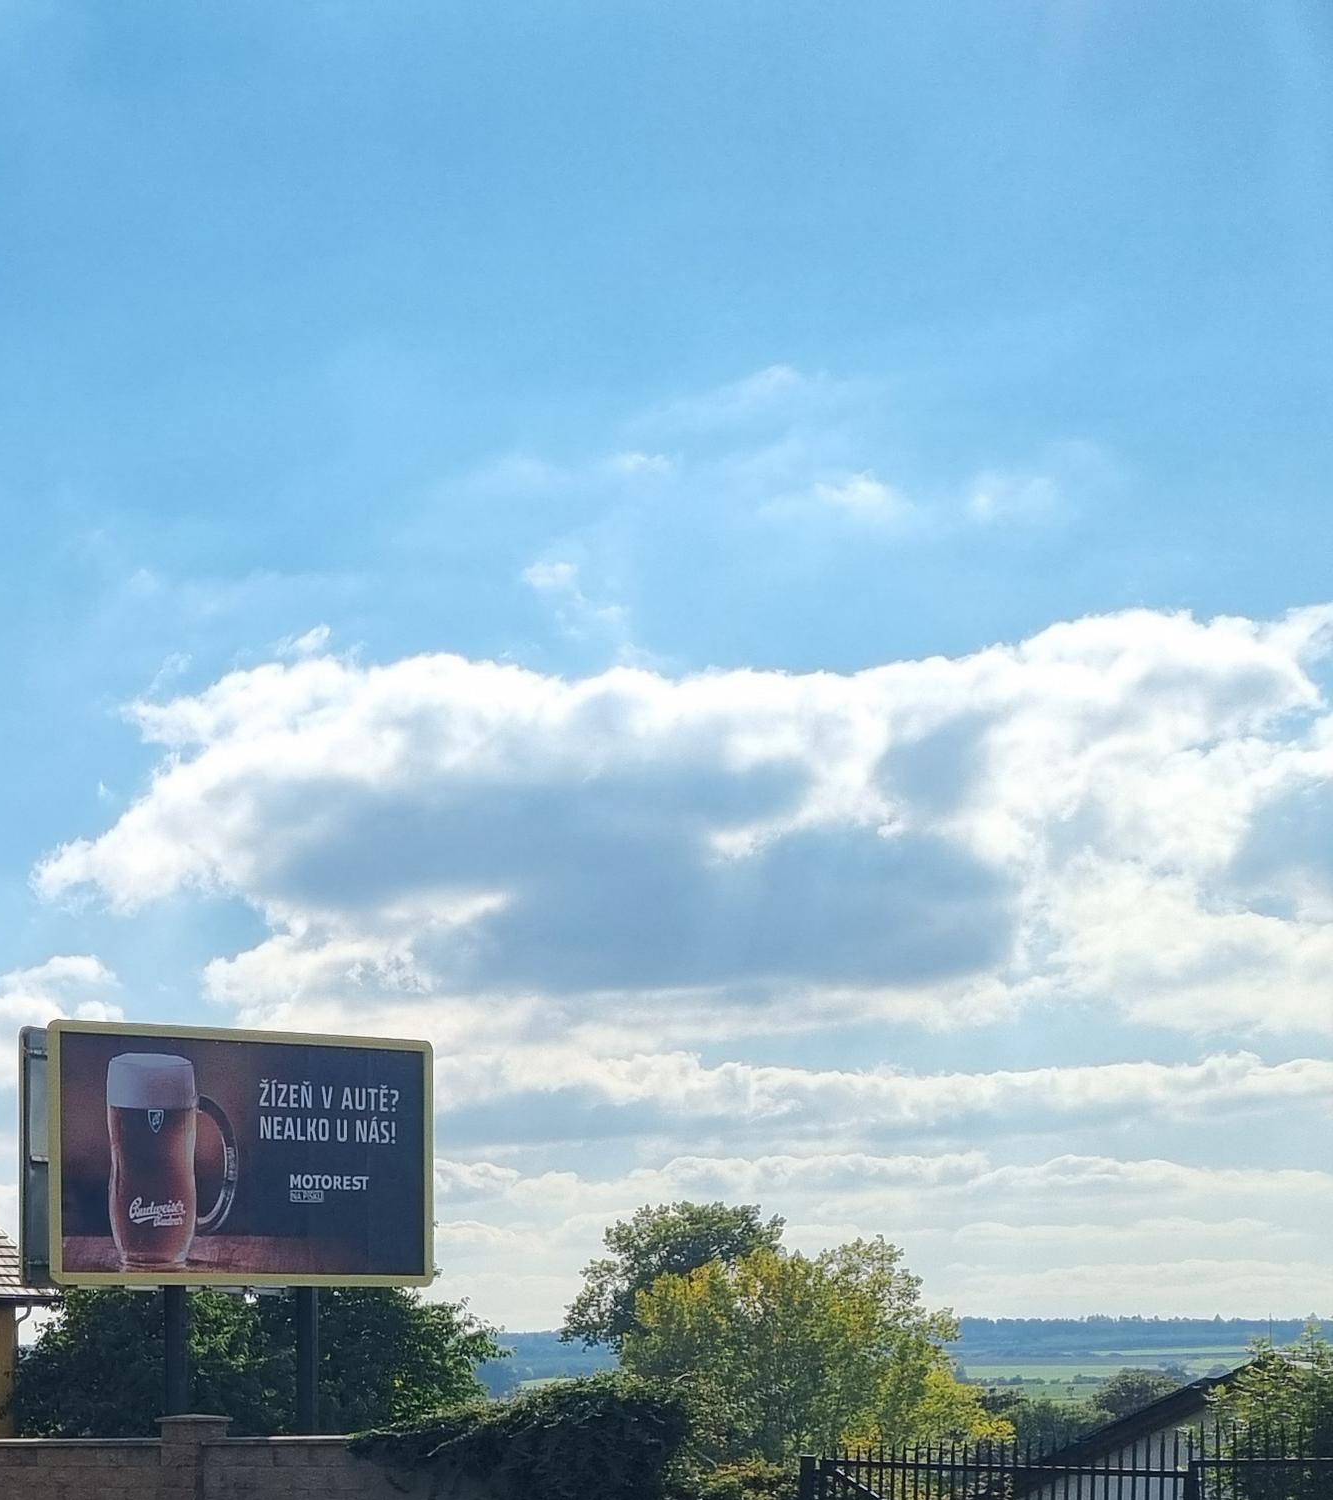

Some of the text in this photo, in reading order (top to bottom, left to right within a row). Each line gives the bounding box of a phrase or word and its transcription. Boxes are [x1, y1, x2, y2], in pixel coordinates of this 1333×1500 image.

[259, 1078, 400, 1113] ŽÍZEŇ V AUTĚ?
[259, 1115, 396, 1144] NEALKO U NÁS!
[289, 1174, 370, 1191] MOTOREST
